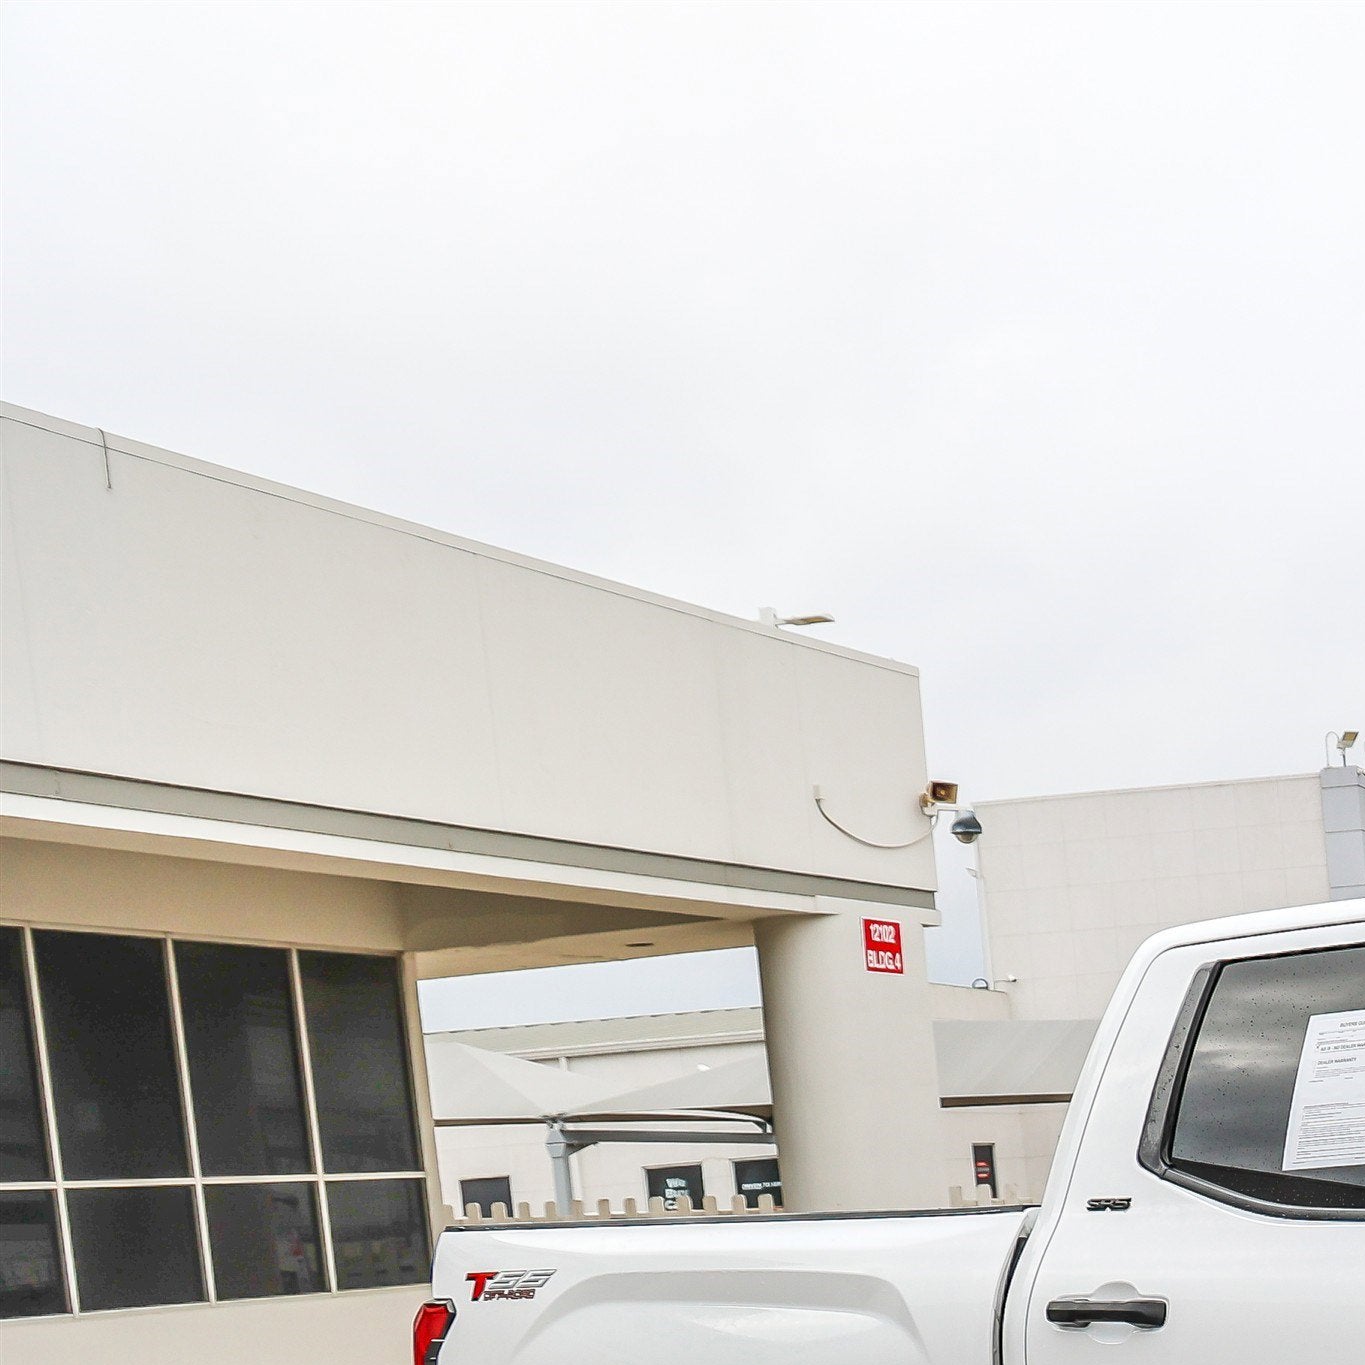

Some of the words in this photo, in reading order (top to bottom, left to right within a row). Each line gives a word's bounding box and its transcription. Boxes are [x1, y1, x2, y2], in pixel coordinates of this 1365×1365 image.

[869, 923, 896, 944] 12102
[867, 949, 894, 970] BLDG
[894, 952, 902, 970] 4
[1087, 1198, 1132, 1212] SR5
